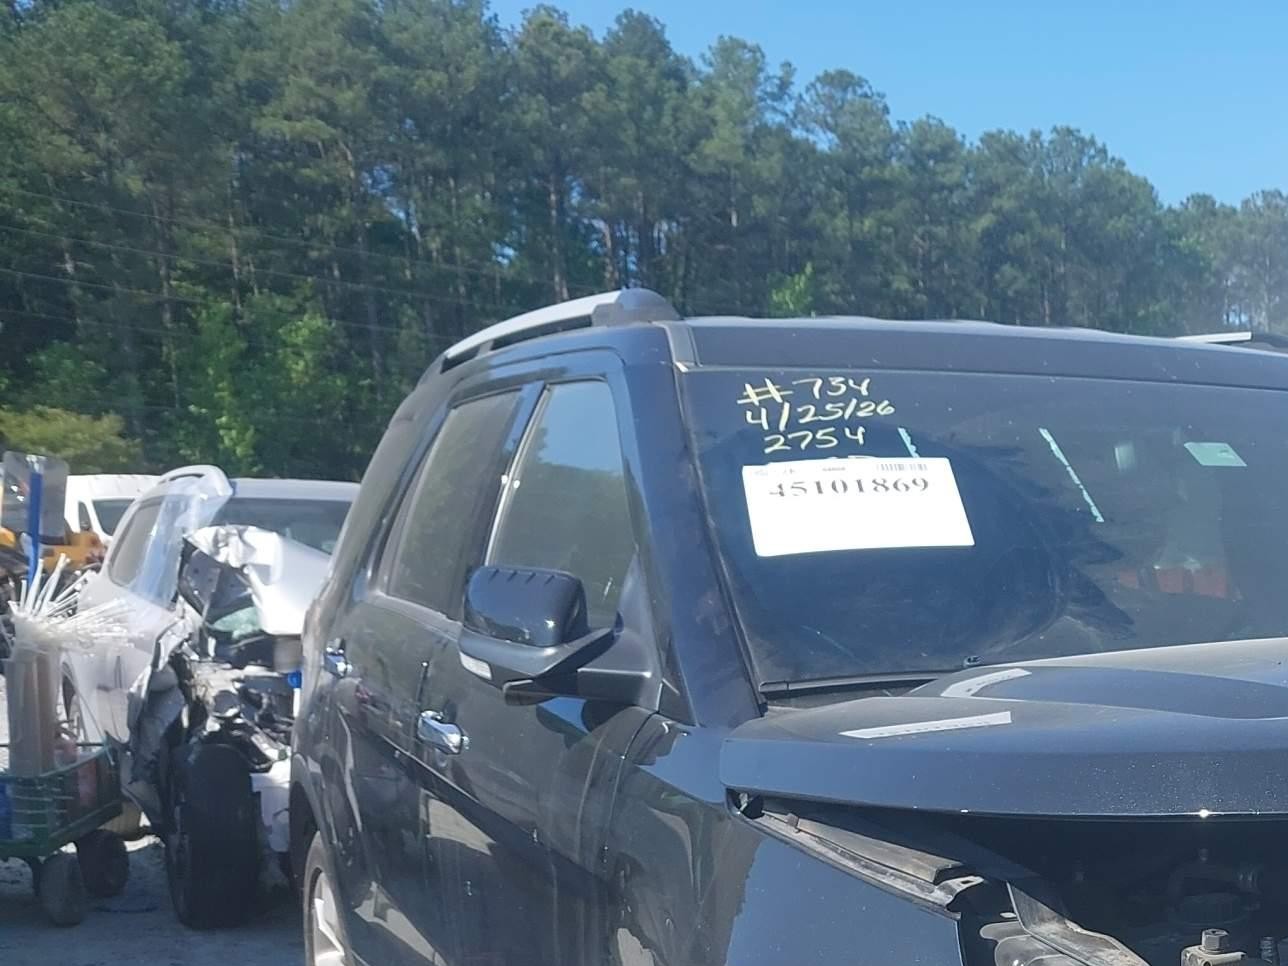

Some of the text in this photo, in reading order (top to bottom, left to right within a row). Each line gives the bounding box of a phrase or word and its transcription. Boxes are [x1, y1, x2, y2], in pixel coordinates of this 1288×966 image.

[745, 398, 895, 432] 4/25/26
[763, 426, 866, 454] 2754
[769, 477, 929, 497] 45101869
